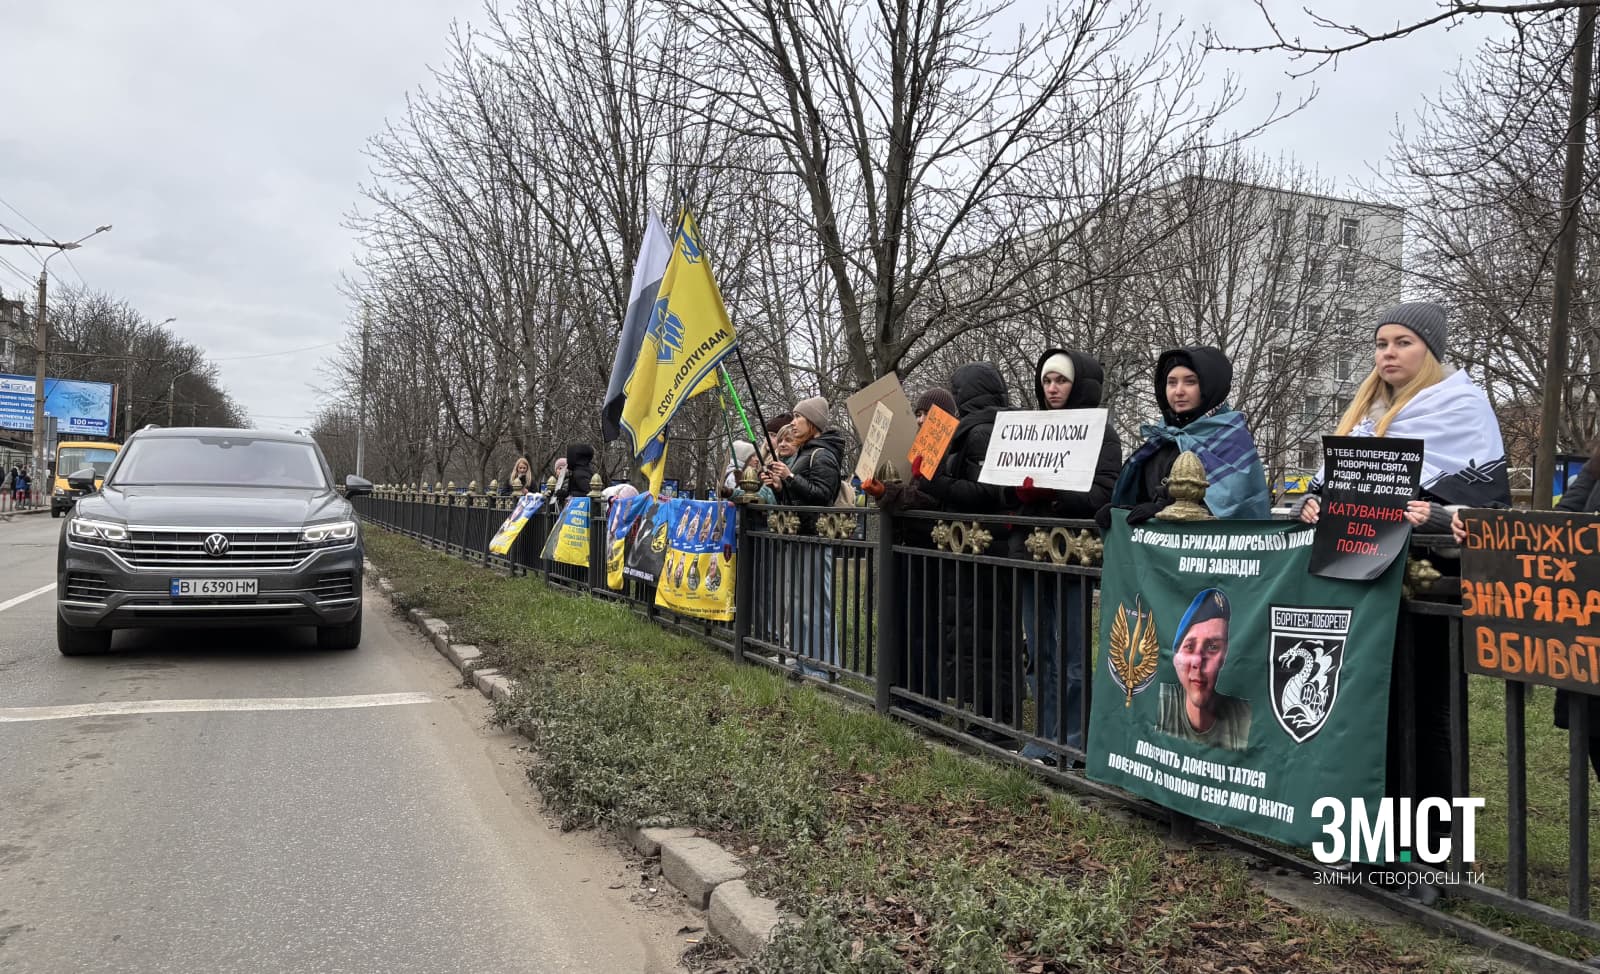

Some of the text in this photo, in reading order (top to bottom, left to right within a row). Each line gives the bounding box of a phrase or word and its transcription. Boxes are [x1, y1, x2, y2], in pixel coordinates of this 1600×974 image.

[1001, 424, 1089, 441] СТАНЬ ГОЛОСОМ
[996, 450, 1071, 473] ПОЛОНЕНИХ
[1326, 448, 1421, 462] В ТЕБЕ ПОПЕРЕДУ 2026
[1337, 460, 1408, 473] НОВОРІЧНІ СВЯТА
[1328, 480, 1334, 489] В
[1335, 481, 1352, 490] НИХ
[1357, 483, 1372, 493] ЩЕ
[1373, 485, 1394, 495] ДОСІ
[1394, 486, 1413, 496] 2022
[1366, 472, 1395, 484] НОВИЙ
[1396, 475, 1412, 485] РІК
[1328, 501, 1404, 521] КАТУВАННЯ
[1347, 522, 1377, 537] БІЛЬ
[1131, 528, 1316, 553] 36 ОКРЕМА БРИГАДА МОРСЬКОЇ ПІХО
[1179, 556, 1260, 578] ВІРНІ ЗАВЖДИ!
[1515, 554, 1577, 582] ТЕЖ
[202, 581, 234, 593] 6390
[1475, 626, 1600, 685] ВБИВСТ
[1227, 766, 1267, 789] ТАТУСЯ
[1163, 774, 1200, 799] ПОЛОНУ
[1201, 785, 1229, 806] СЕНС
[1228, 791, 1257, 814] МОГО
[1258, 797, 1295, 824] ЖИТТЯ
